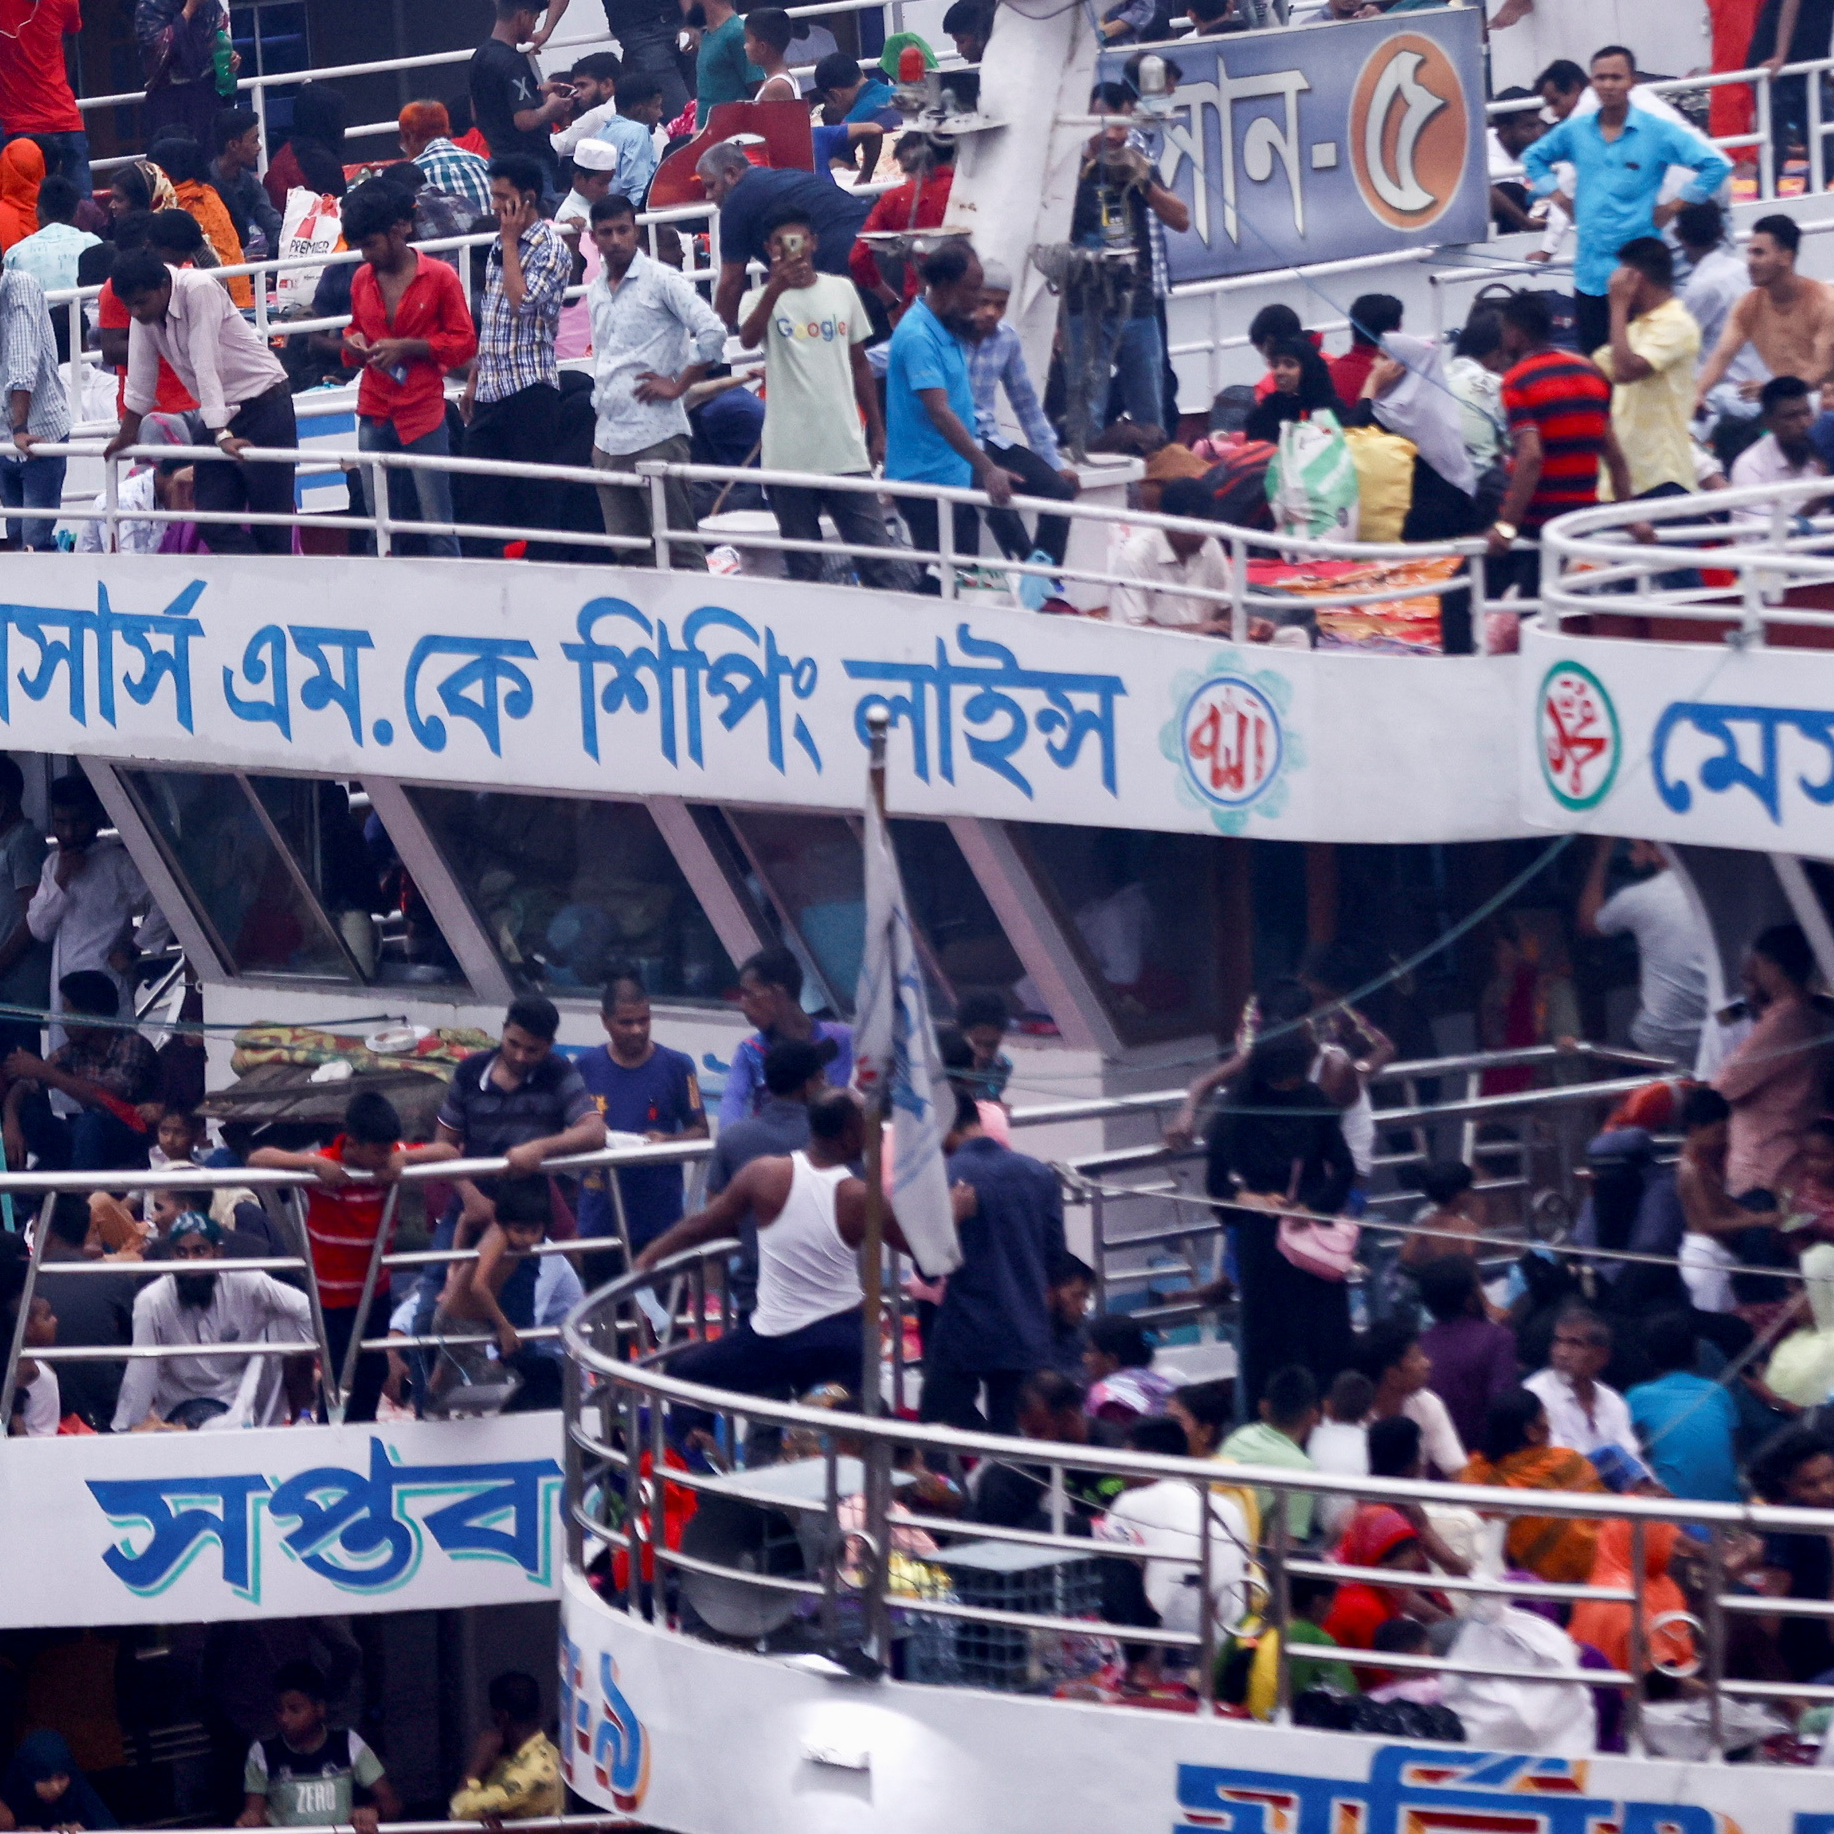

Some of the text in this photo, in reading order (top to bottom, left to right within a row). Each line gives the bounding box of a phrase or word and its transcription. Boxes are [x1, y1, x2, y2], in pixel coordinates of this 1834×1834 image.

[776, 313, 847, 343] Google
[561, 596, 823, 776] শিপিং
[84, 1434, 567, 1596] সপ্তব
